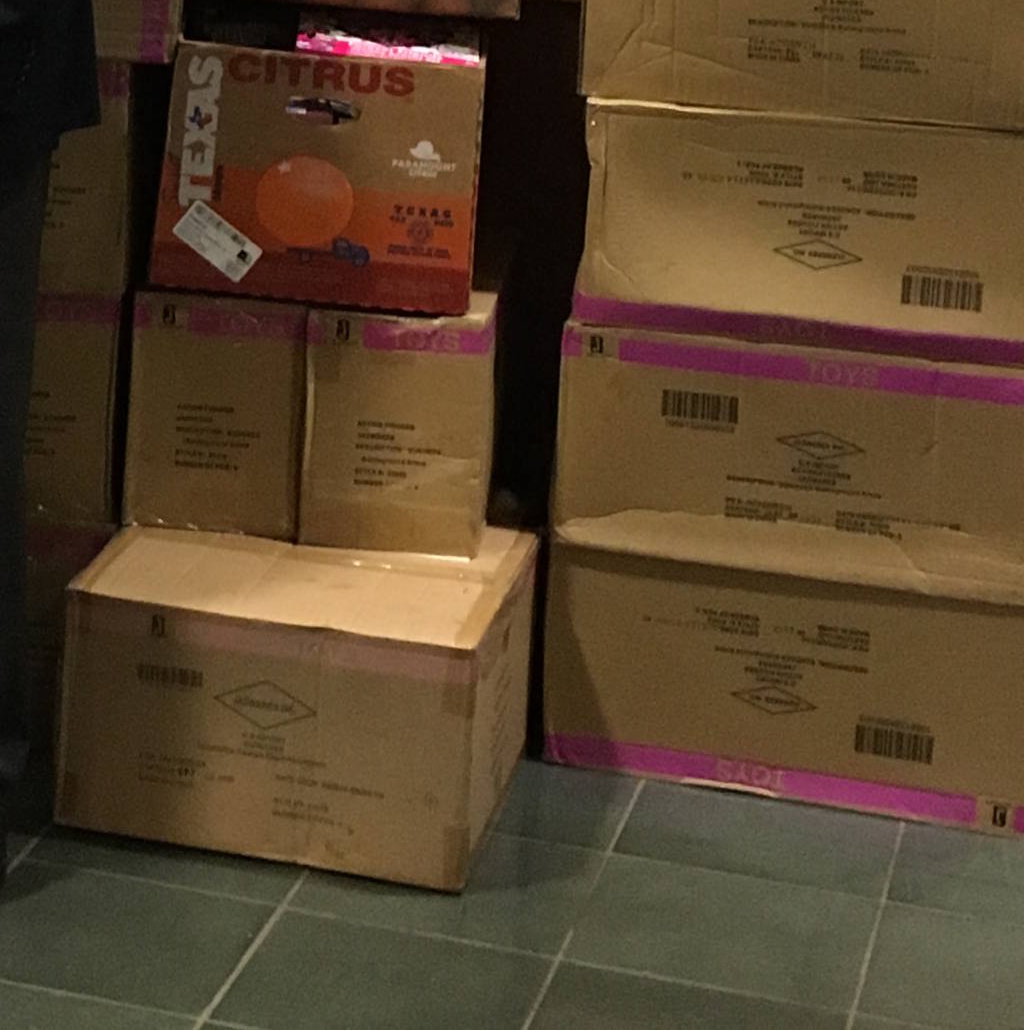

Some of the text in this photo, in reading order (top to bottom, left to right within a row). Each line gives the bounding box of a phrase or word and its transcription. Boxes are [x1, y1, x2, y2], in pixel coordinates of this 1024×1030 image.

[228, 51, 415, 96] CITRUS
[179, 55, 223, 206] TEXAS
[392, 158, 456, 171] PARAMOUNT
[394, 204, 452, 219] TEXAS
[808, 360, 876, 386] TOYS
